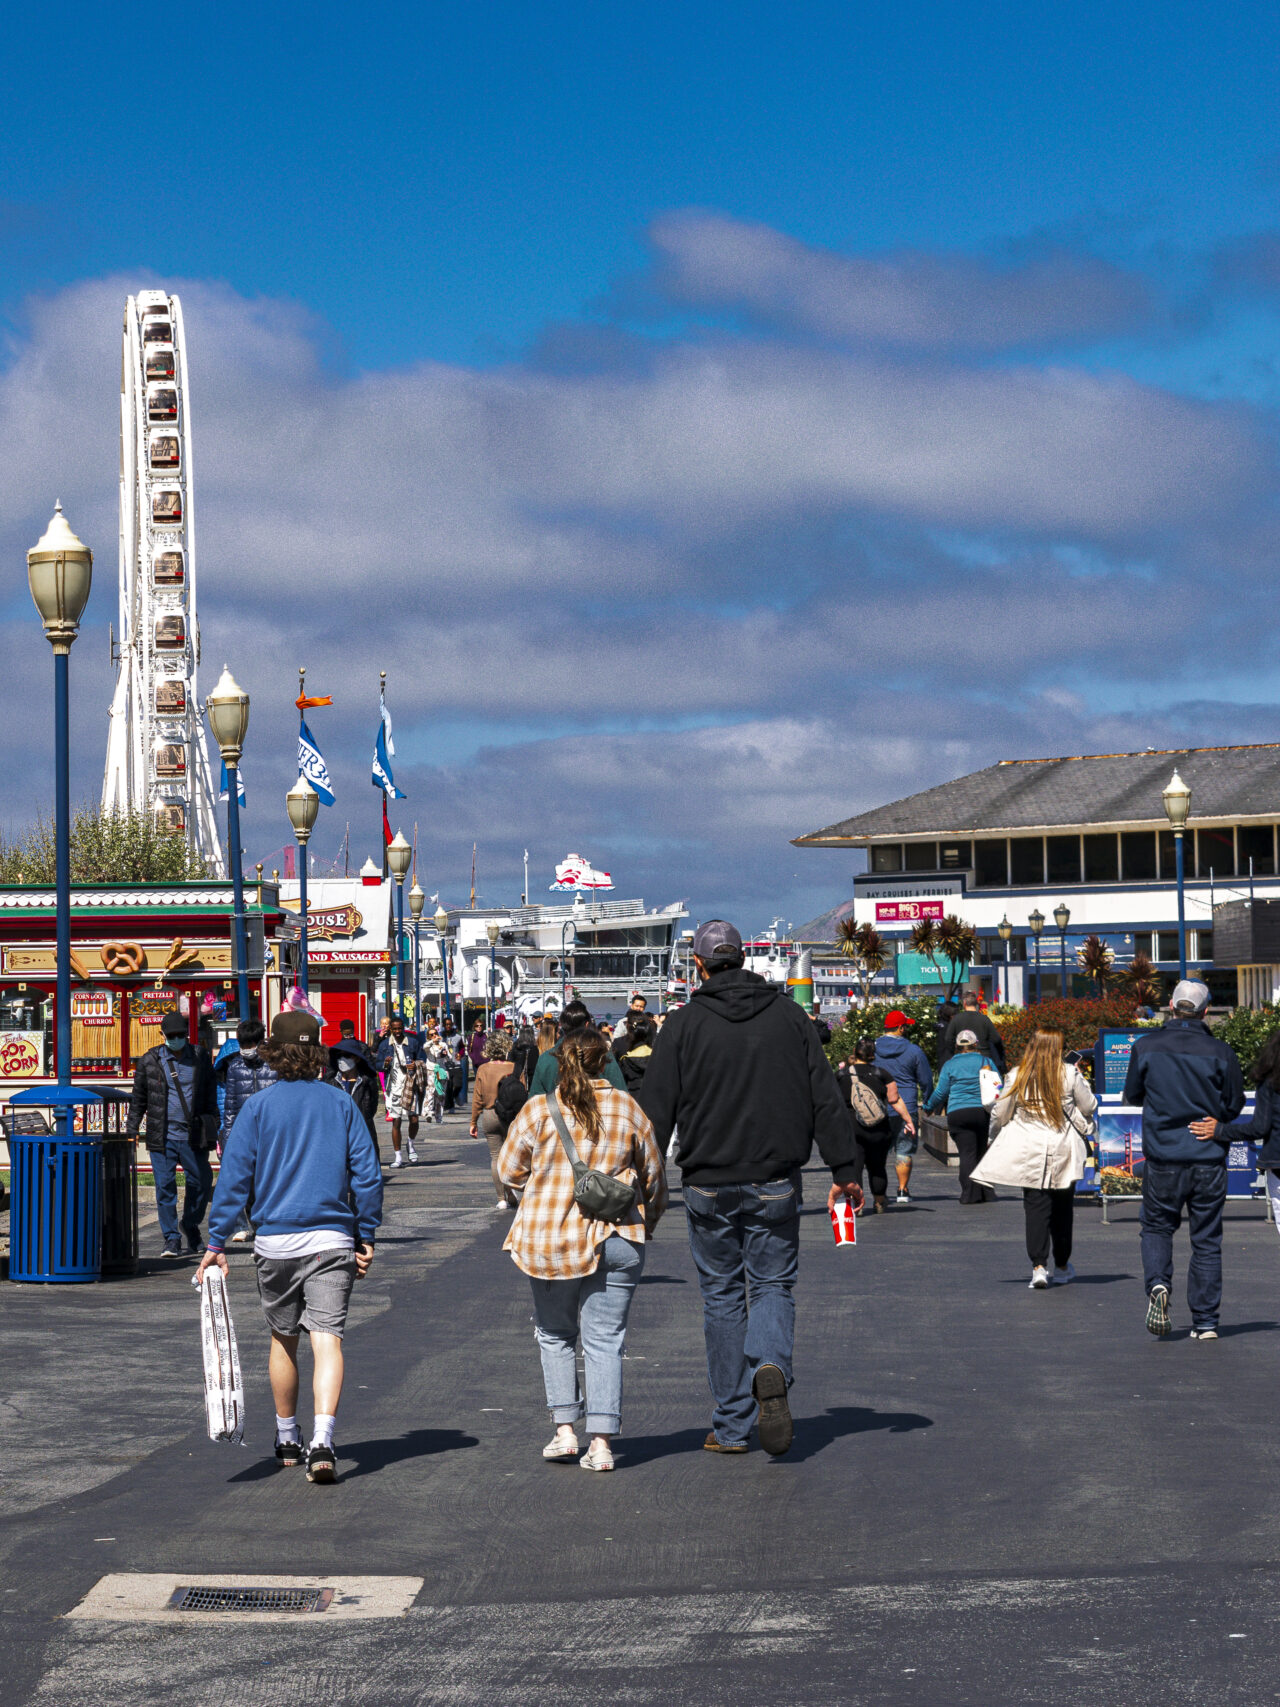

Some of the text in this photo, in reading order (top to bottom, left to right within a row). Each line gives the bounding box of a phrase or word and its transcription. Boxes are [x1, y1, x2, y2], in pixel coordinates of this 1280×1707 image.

[883, 890, 912, 898] CRUISES
[923, 888, 952, 896] FERRIES
[899, 904, 910, 912] BIG
[307, 913, 347, 926] OUSE
[331, 951, 381, 961] SAUSAGES
[1, 1043, 26, 1062] POP
[3, 1054, 39, 1074] CORN
